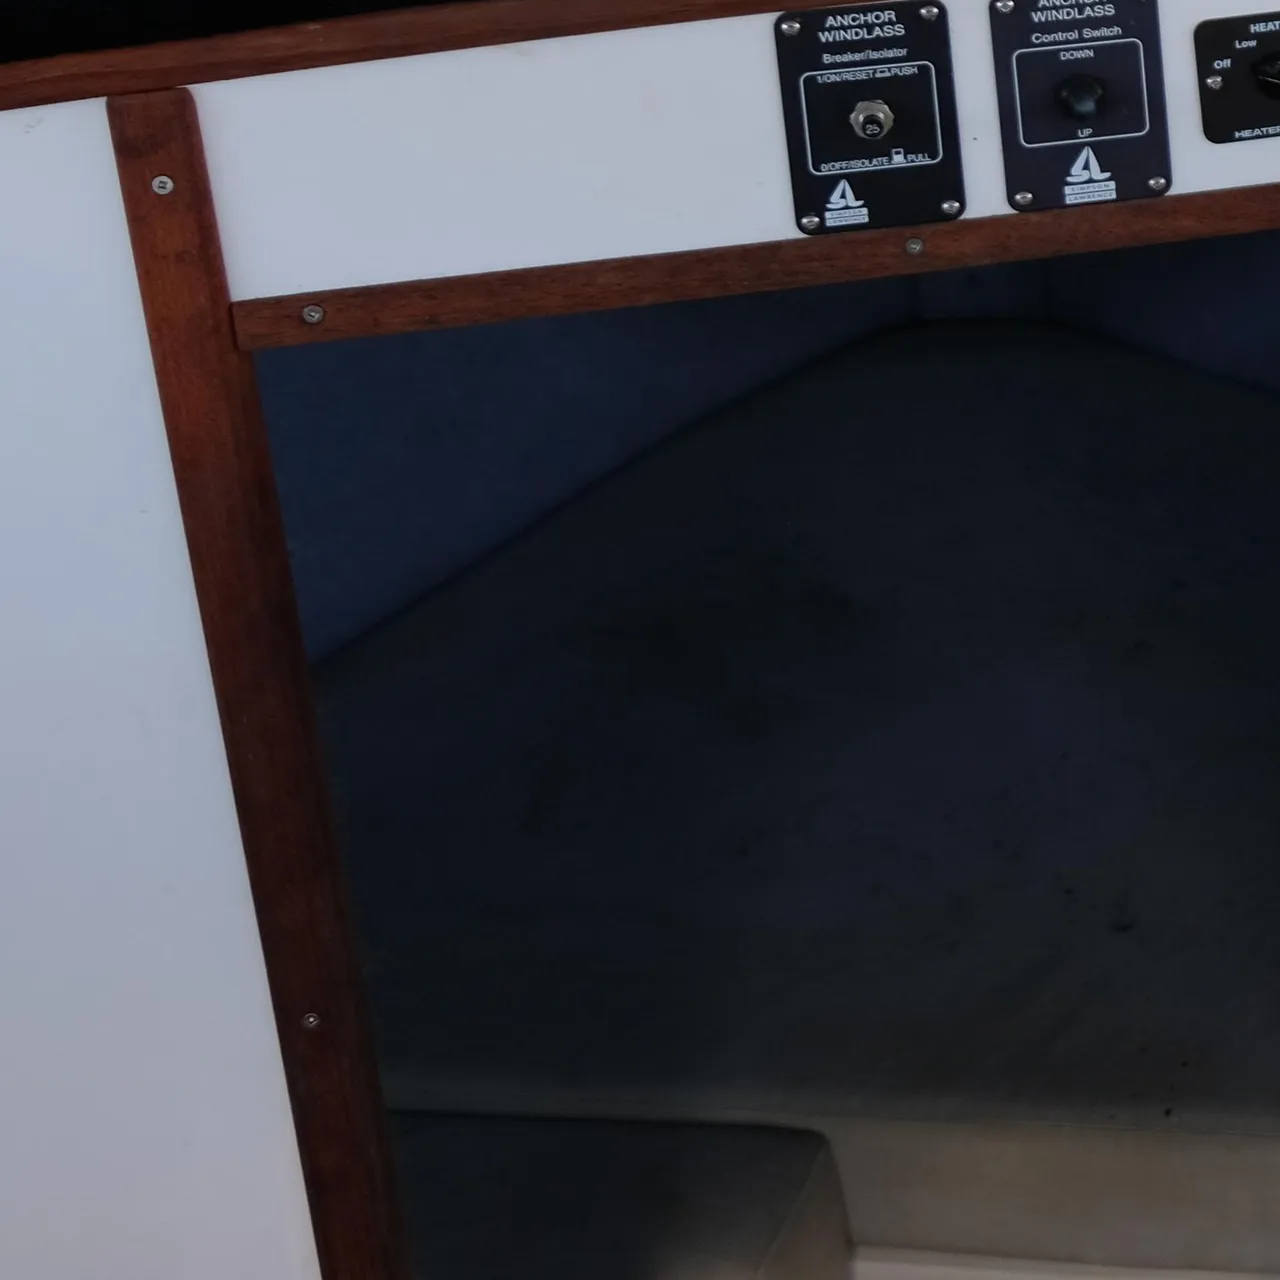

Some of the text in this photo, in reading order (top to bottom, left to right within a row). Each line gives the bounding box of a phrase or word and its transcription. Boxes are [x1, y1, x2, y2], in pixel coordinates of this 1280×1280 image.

[1031, 4, 1115, 22] WINDLASS
[825, 10, 897, 28] ANCHOR
[818, 23, 905, 42] WINDLASS
[1031, 25, 1122, 44] Control Switch
[1235, 40, 1257, 49] Low
[822, 47, 909, 64] Breaker/Isolator
[1060, 48, 1094, 60] DOWN
[1213, 58, 1231, 69] Off
[891, 66, 918, 77] PUSH
[865, 123, 880, 134] 25
[1078, 128, 1093, 137] UP
[907, 153, 931, 162] PULL
